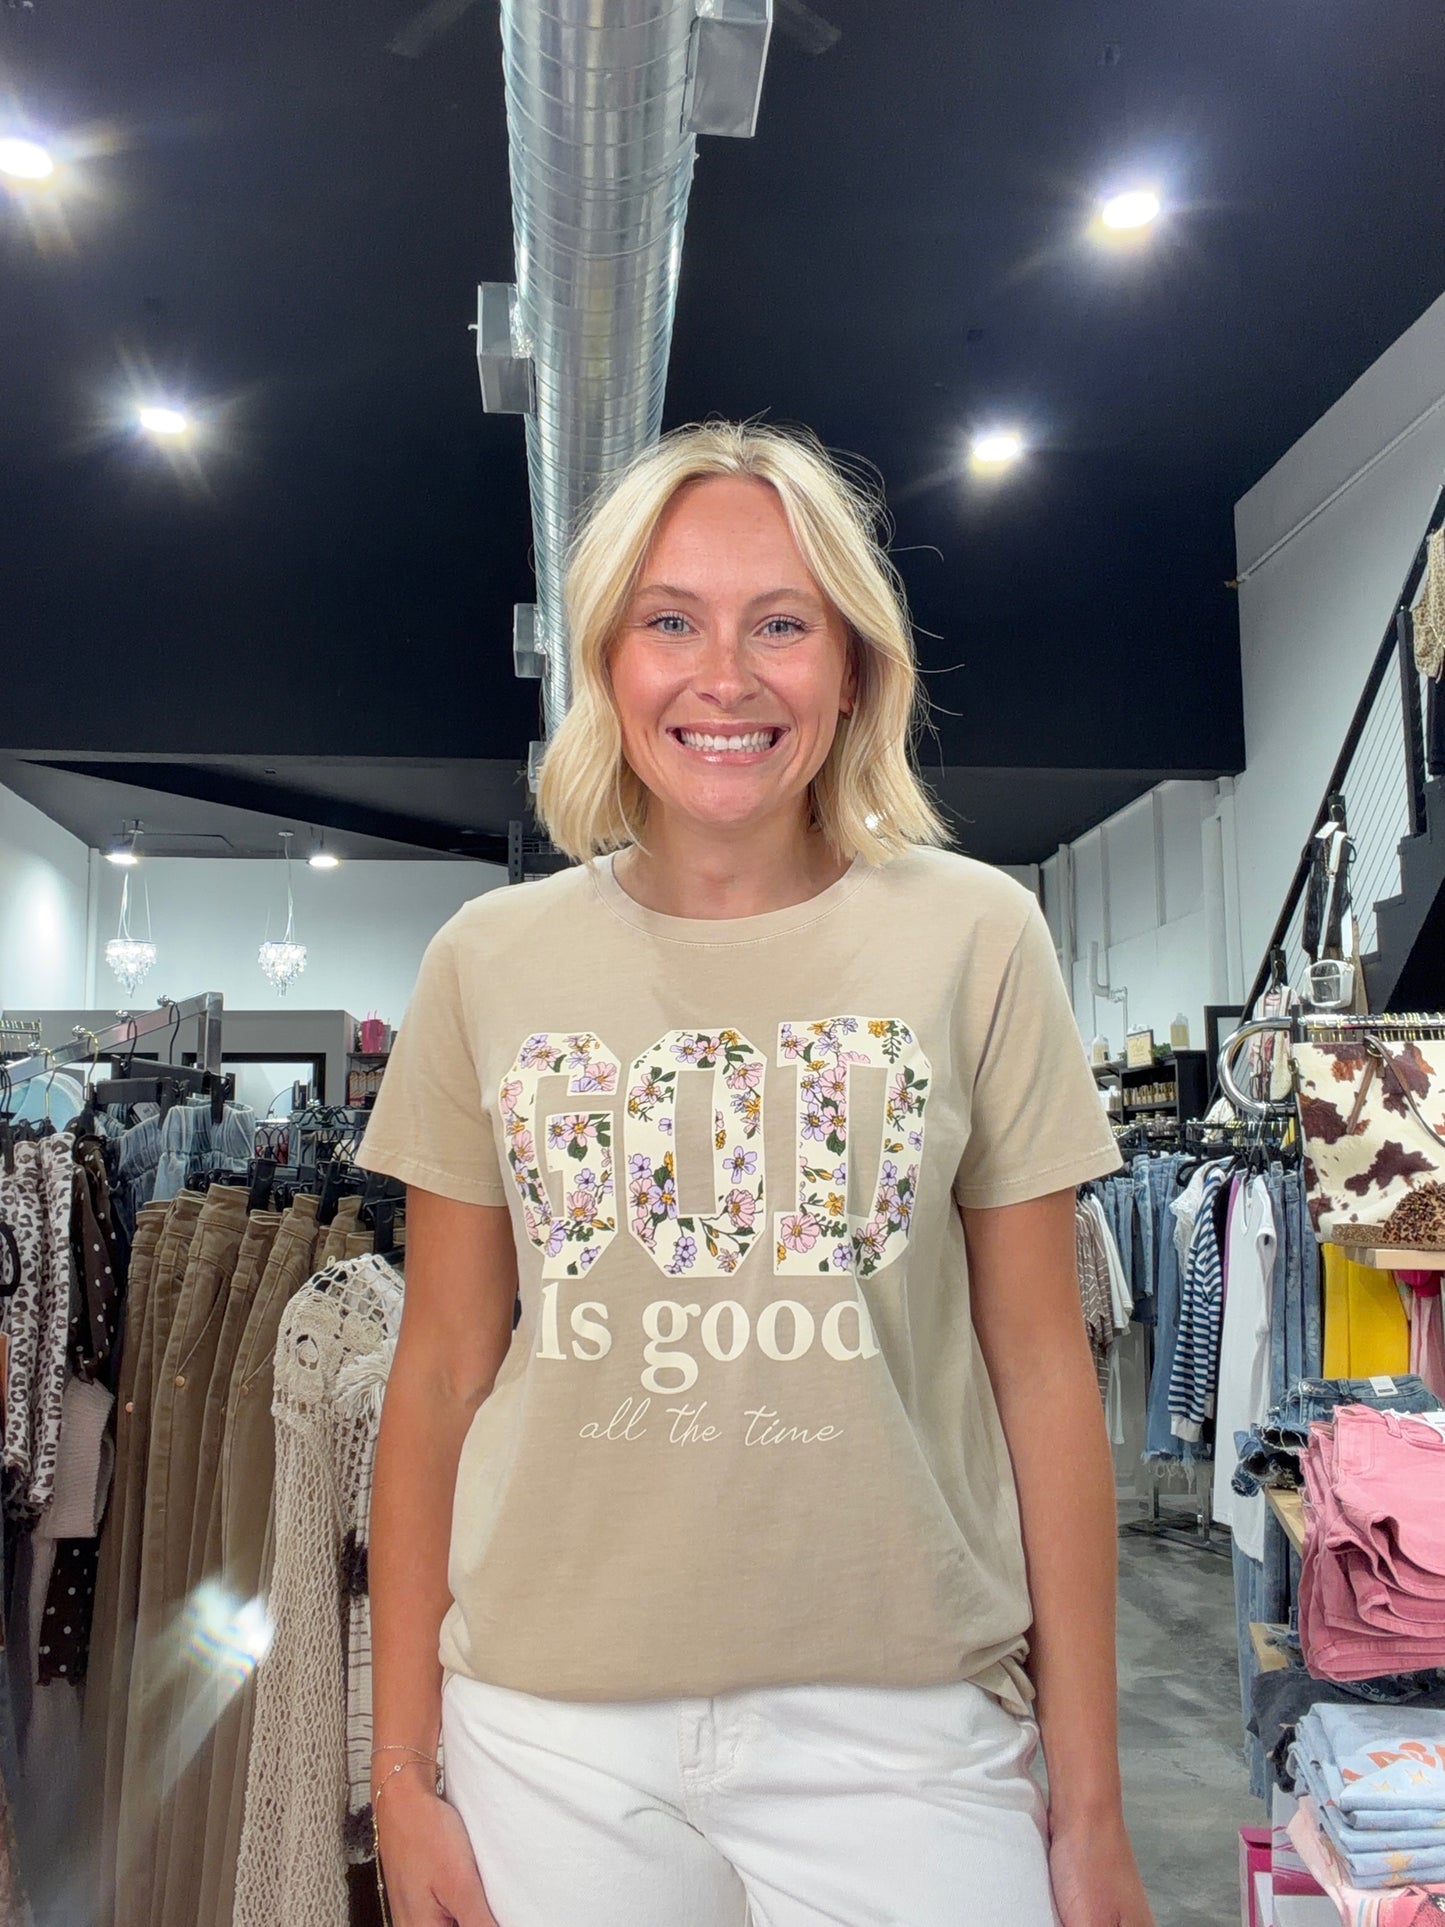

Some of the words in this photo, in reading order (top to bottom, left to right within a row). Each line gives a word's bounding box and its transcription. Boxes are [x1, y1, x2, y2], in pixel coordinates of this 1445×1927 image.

[499, 1015, 933, 1280] GOD
[640, 1284, 879, 1395] good
[578, 1396, 647, 1441] all
[665, 1401, 722, 1447] the
[743, 1405, 844, 1447] time
